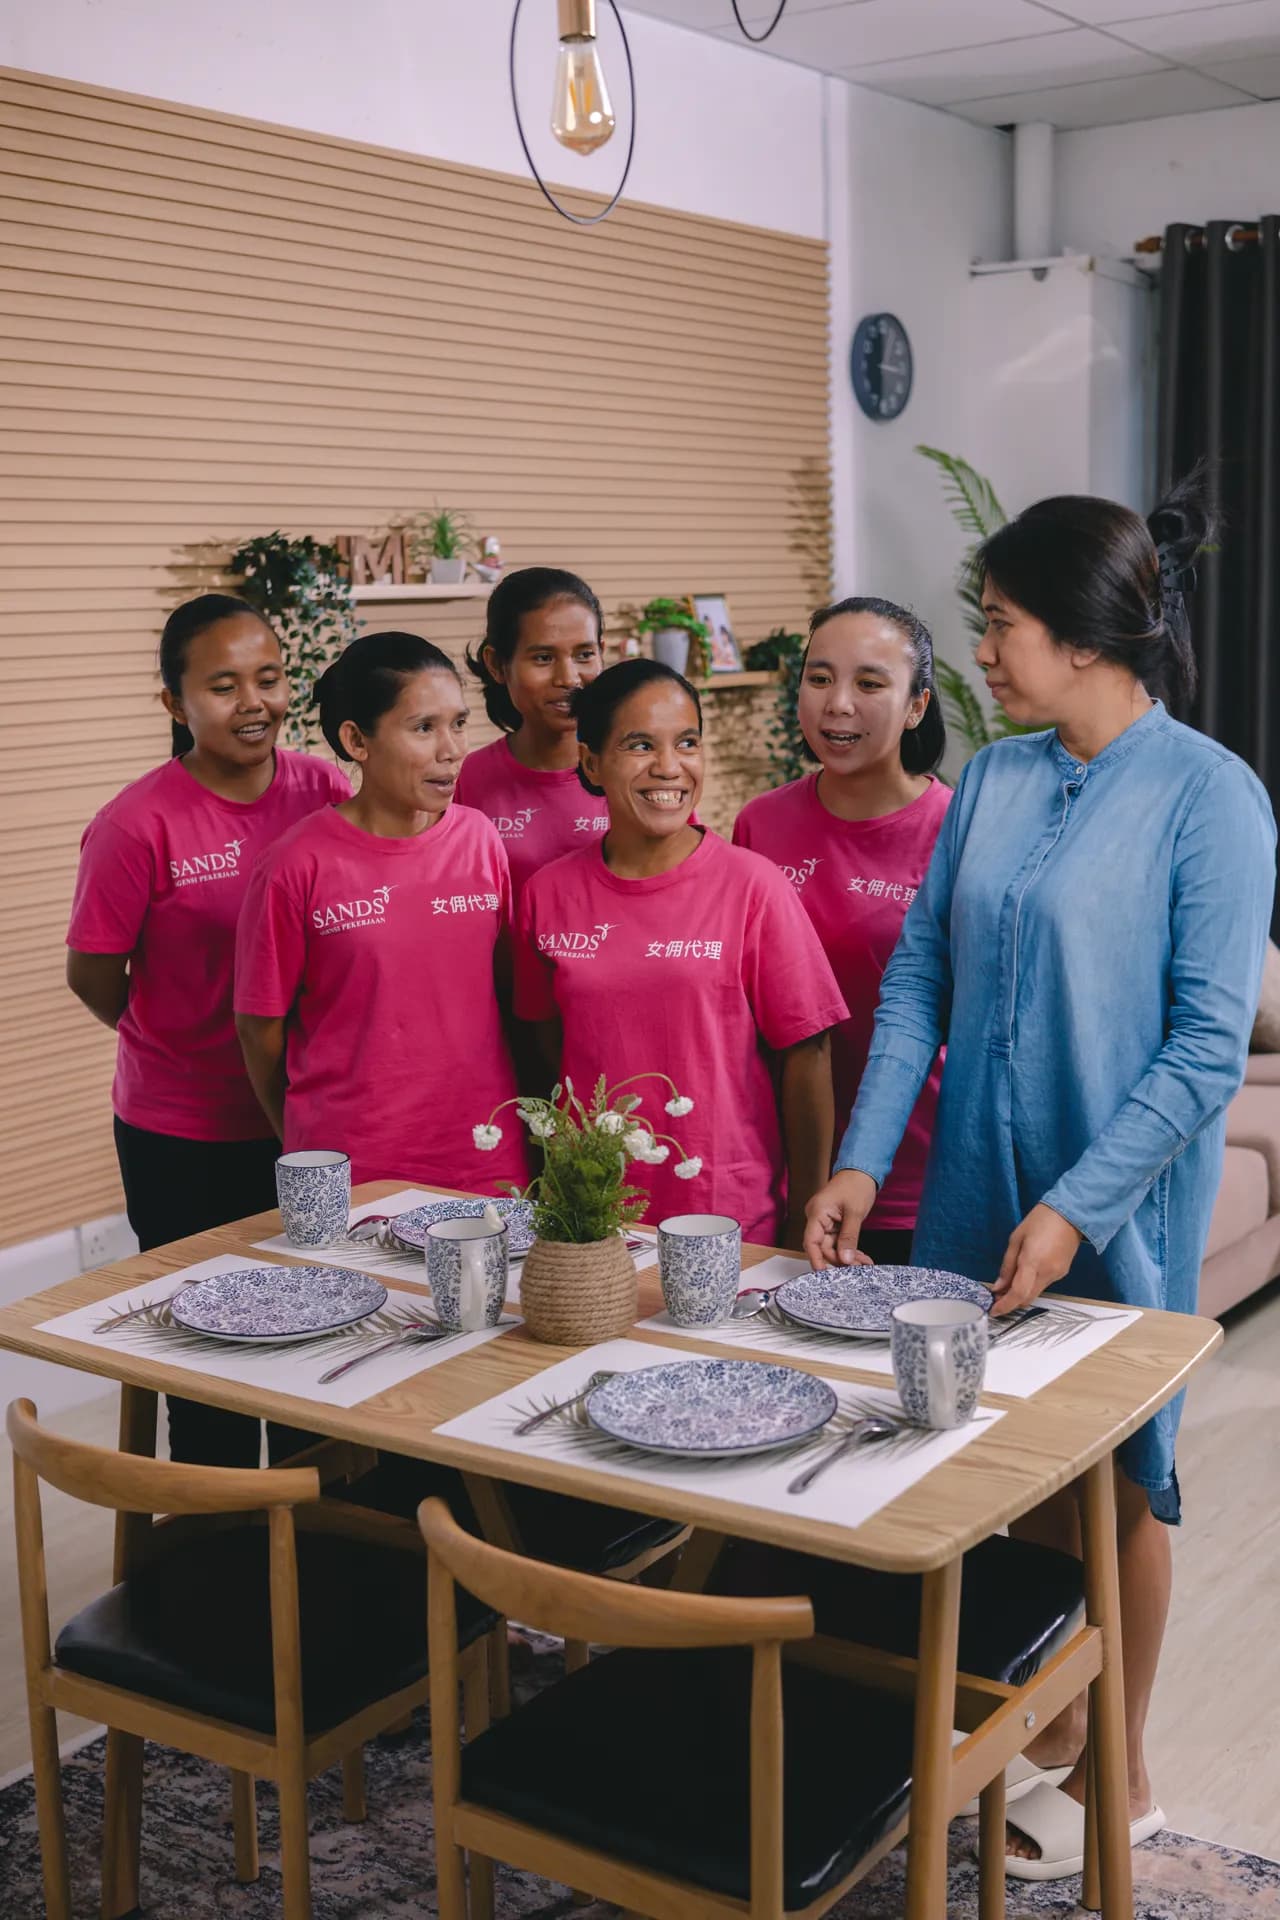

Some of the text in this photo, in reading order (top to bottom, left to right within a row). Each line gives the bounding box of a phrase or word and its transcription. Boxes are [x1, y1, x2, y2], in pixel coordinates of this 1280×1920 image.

[573, 816, 609, 832] 女佣
[169, 851, 238, 879] SANDS
[312, 897, 386, 930] SANDS
[430, 893, 500, 915] 女佣代理
[341, 917, 386, 931] PEKERJAAN
[537, 932, 602, 952] SANDS
[644, 939, 723, 960] 女佣代理
